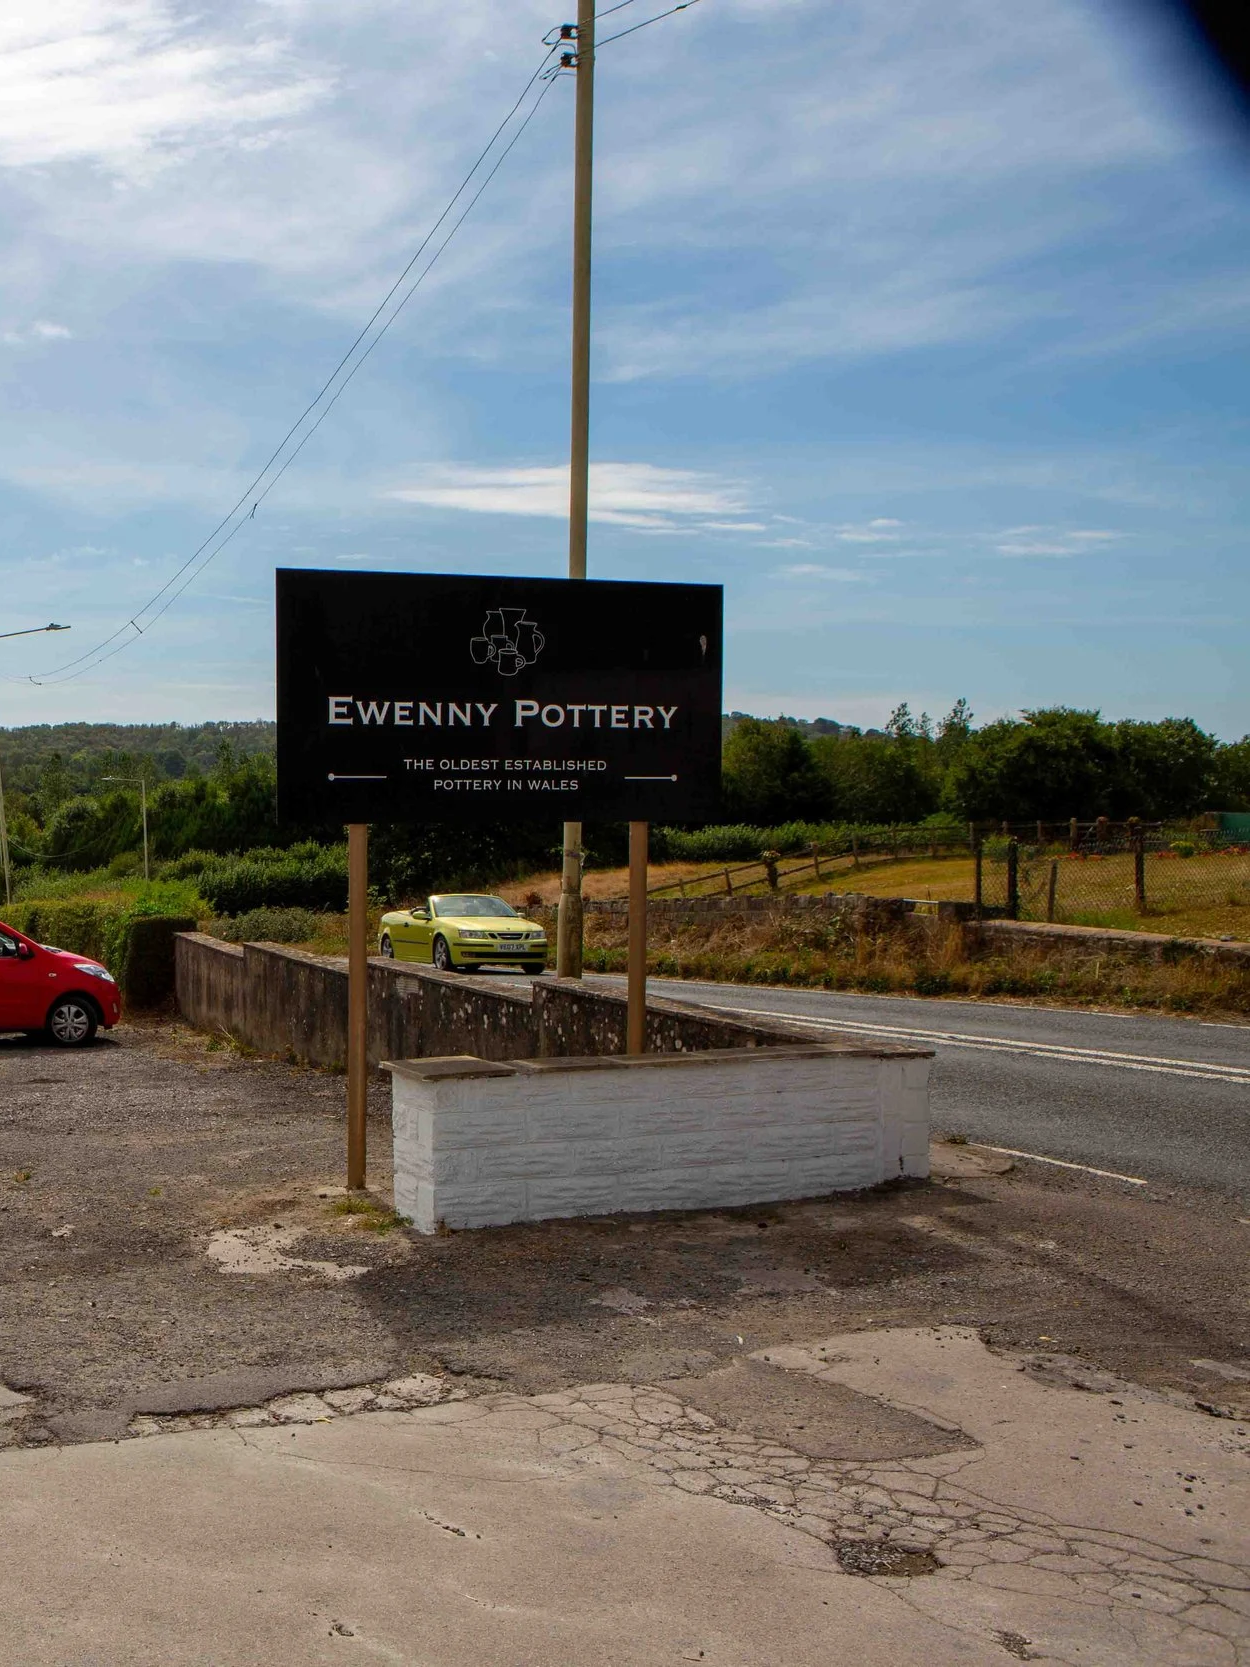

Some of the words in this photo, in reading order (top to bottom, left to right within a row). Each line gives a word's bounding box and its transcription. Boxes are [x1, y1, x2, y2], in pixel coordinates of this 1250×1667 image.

[327, 695, 499, 727] EWENNY
[513, 699, 679, 729] POTTERY
[403, 759, 435, 770] THE
[439, 759, 500, 771] OLDEST
[504, 760, 607, 771] ESTABLISHED
[433, 780, 502, 791] POTTERY
[507, 780, 522, 791] IN
[527, 780, 579, 791] WALES
